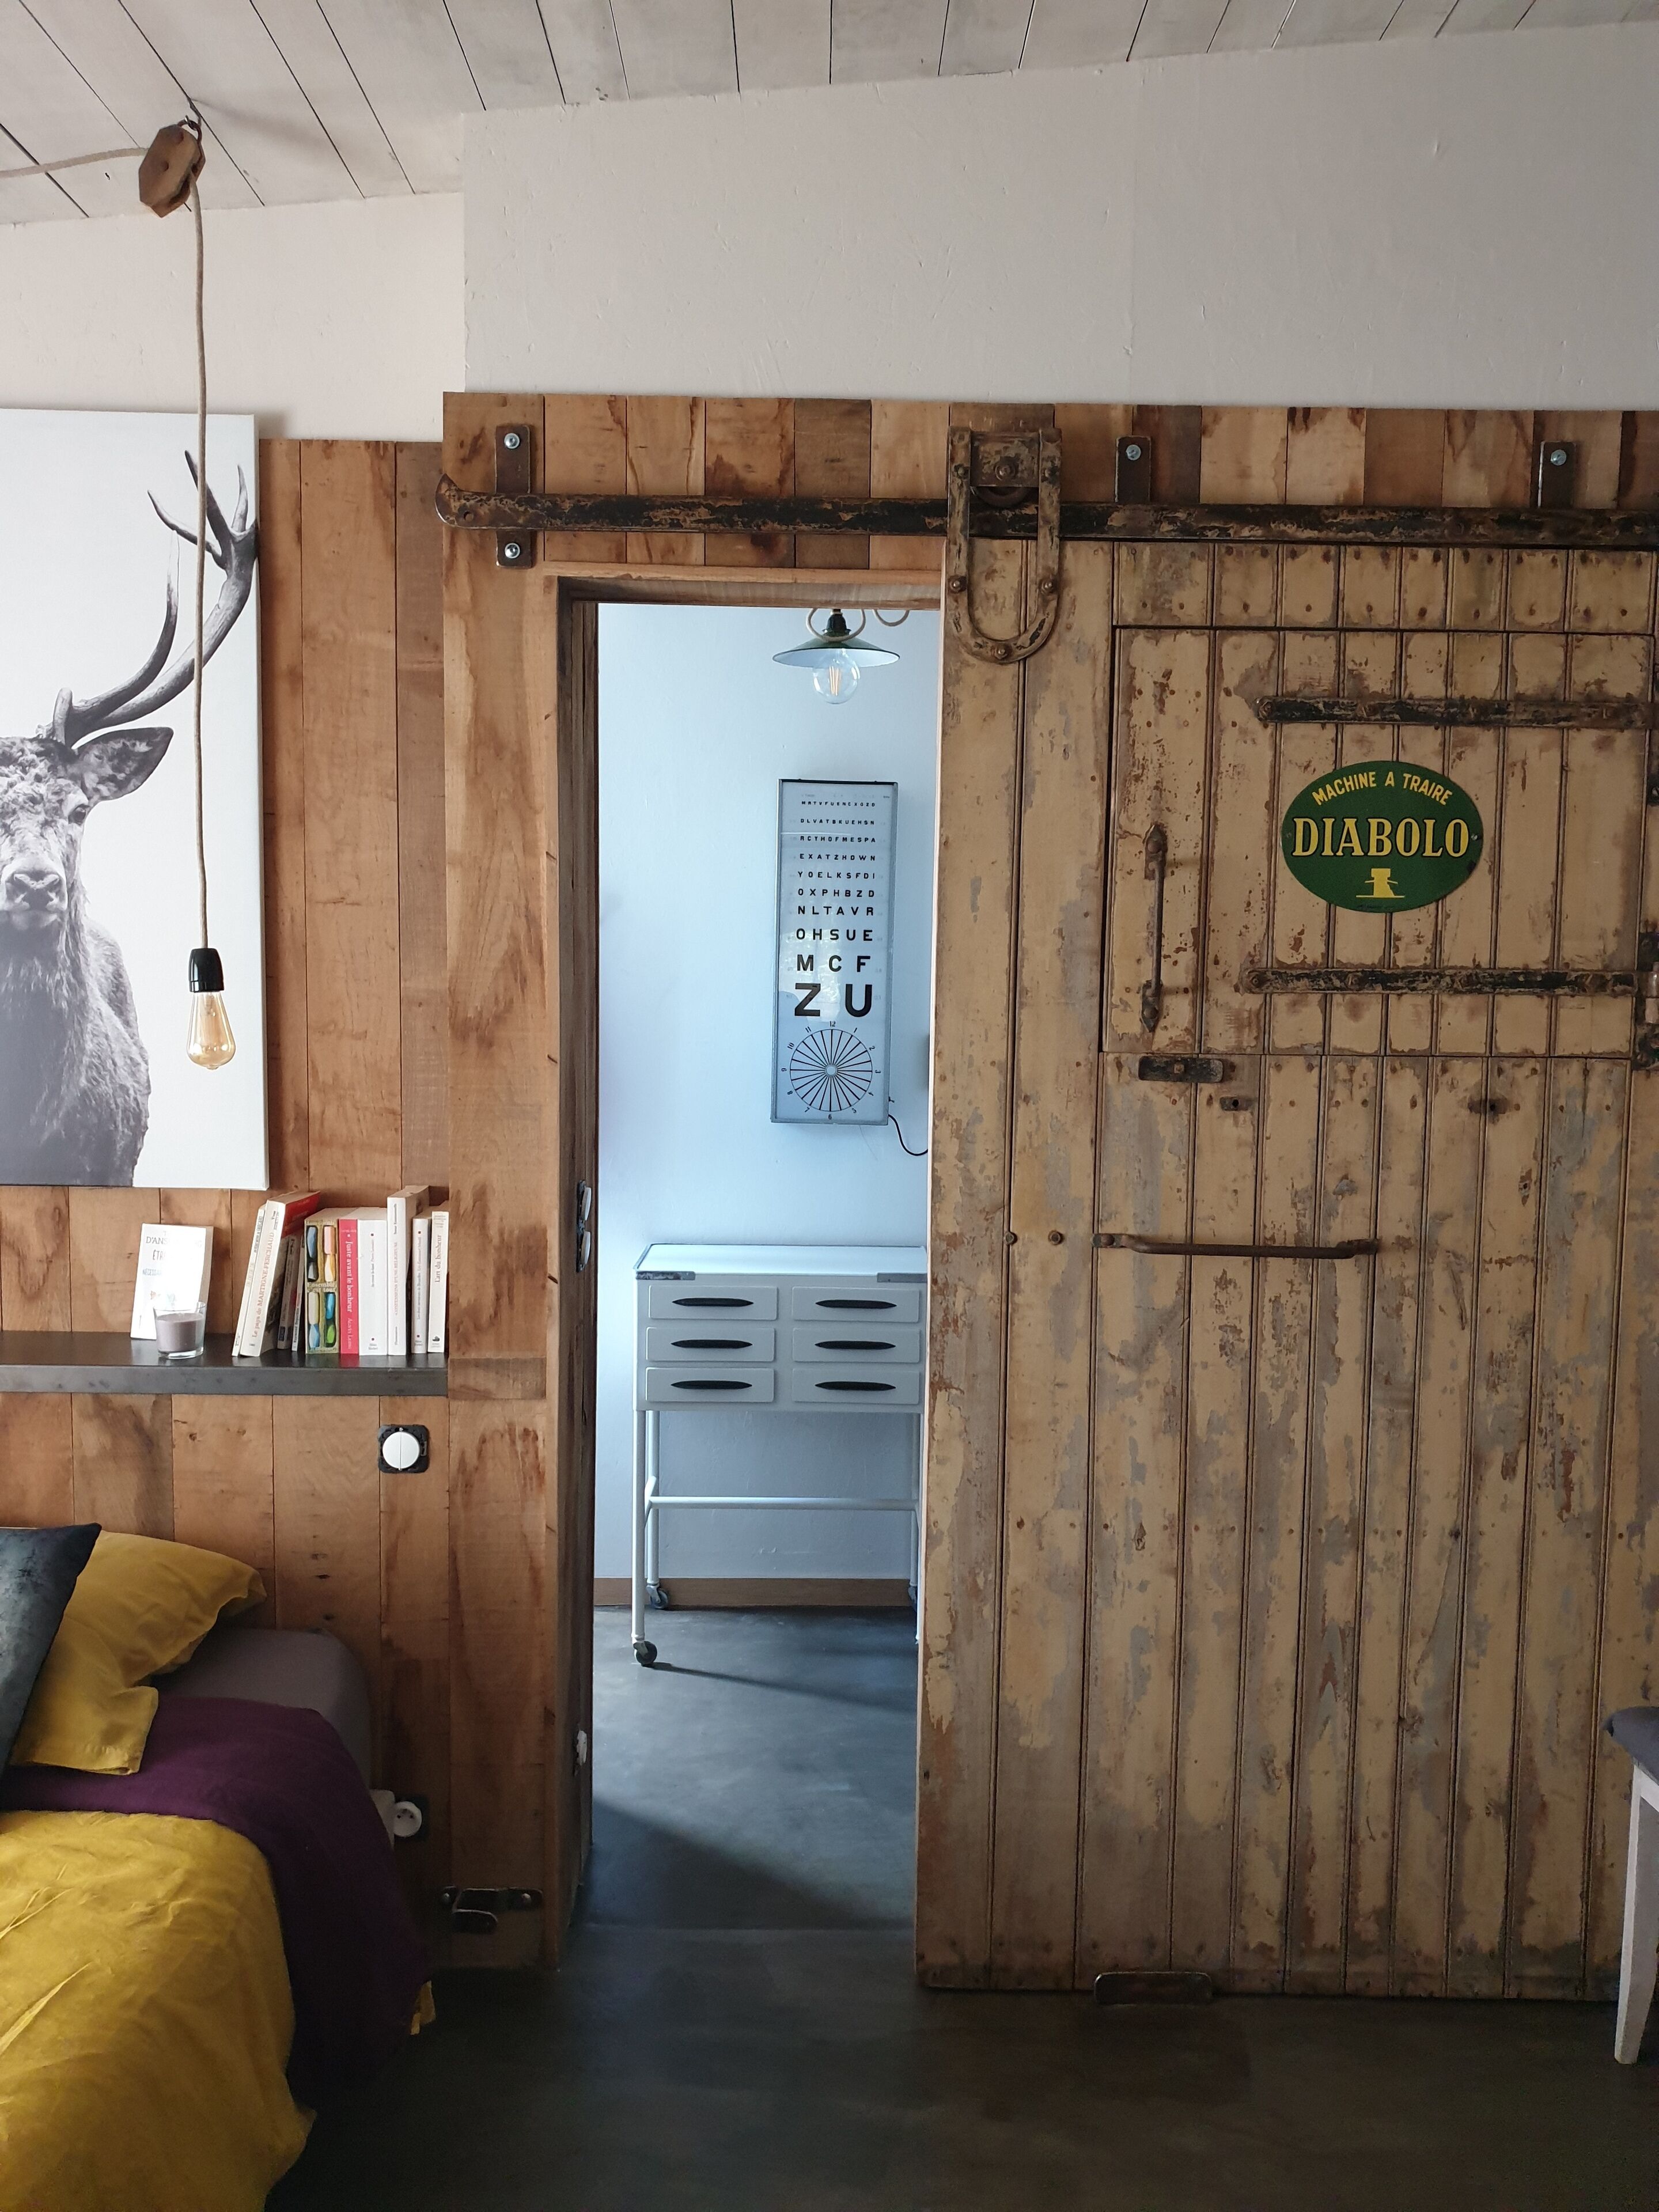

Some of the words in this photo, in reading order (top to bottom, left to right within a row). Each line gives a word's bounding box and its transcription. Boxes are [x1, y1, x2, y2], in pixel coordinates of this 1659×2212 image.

[1312, 771, 1376, 806] MACHINE
[1385, 771, 1395, 787] A
[1403, 773, 1453, 805] TRAIRE
[1291, 817, 1469, 857] DIABOLO
[345, 1241, 353, 1257] Juste
[435, 1261, 441, 1269] du
[256, 1307, 262, 1315] de
